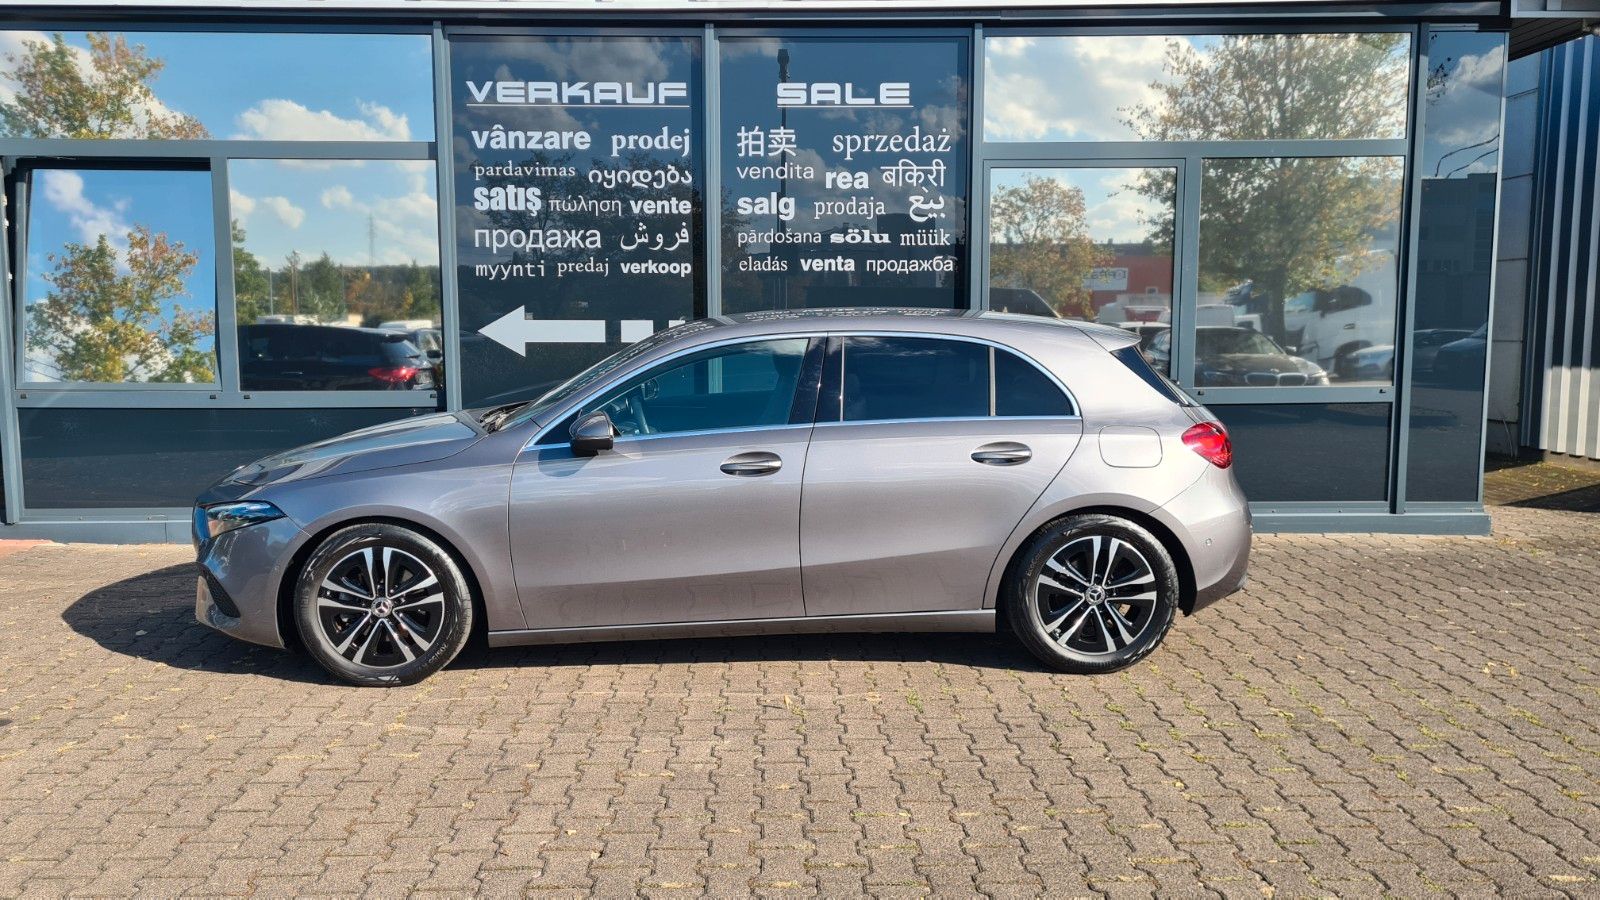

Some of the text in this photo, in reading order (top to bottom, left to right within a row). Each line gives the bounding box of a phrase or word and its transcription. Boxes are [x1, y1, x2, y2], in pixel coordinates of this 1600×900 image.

[466, 81, 686, 103] VERKAUF
[777, 83, 909, 104] SALE
[472, 125, 689, 157] vânzare prodej
[737, 126, 796, 156] 拍卖
[833, 126, 951, 160] sprzedaż
[475, 160, 575, 180] pardavimas
[589, 165, 692, 188] იყიდება
[737, 162, 869, 189] vendita rea
[474, 185, 541, 216] satış
[549, 195, 621, 216] πώληση
[630, 197, 691, 214] vente
[737, 192, 885, 220] salg prodaja
[475, 229, 601, 253] продажа
[621, 222, 689, 251] فروش
[738, 228, 950, 247] pārdošana sölu müük
[476, 257, 691, 280] myynti predaj verkoop
[740, 256, 855, 271] eladás venta
[867, 256, 953, 274] продажба
